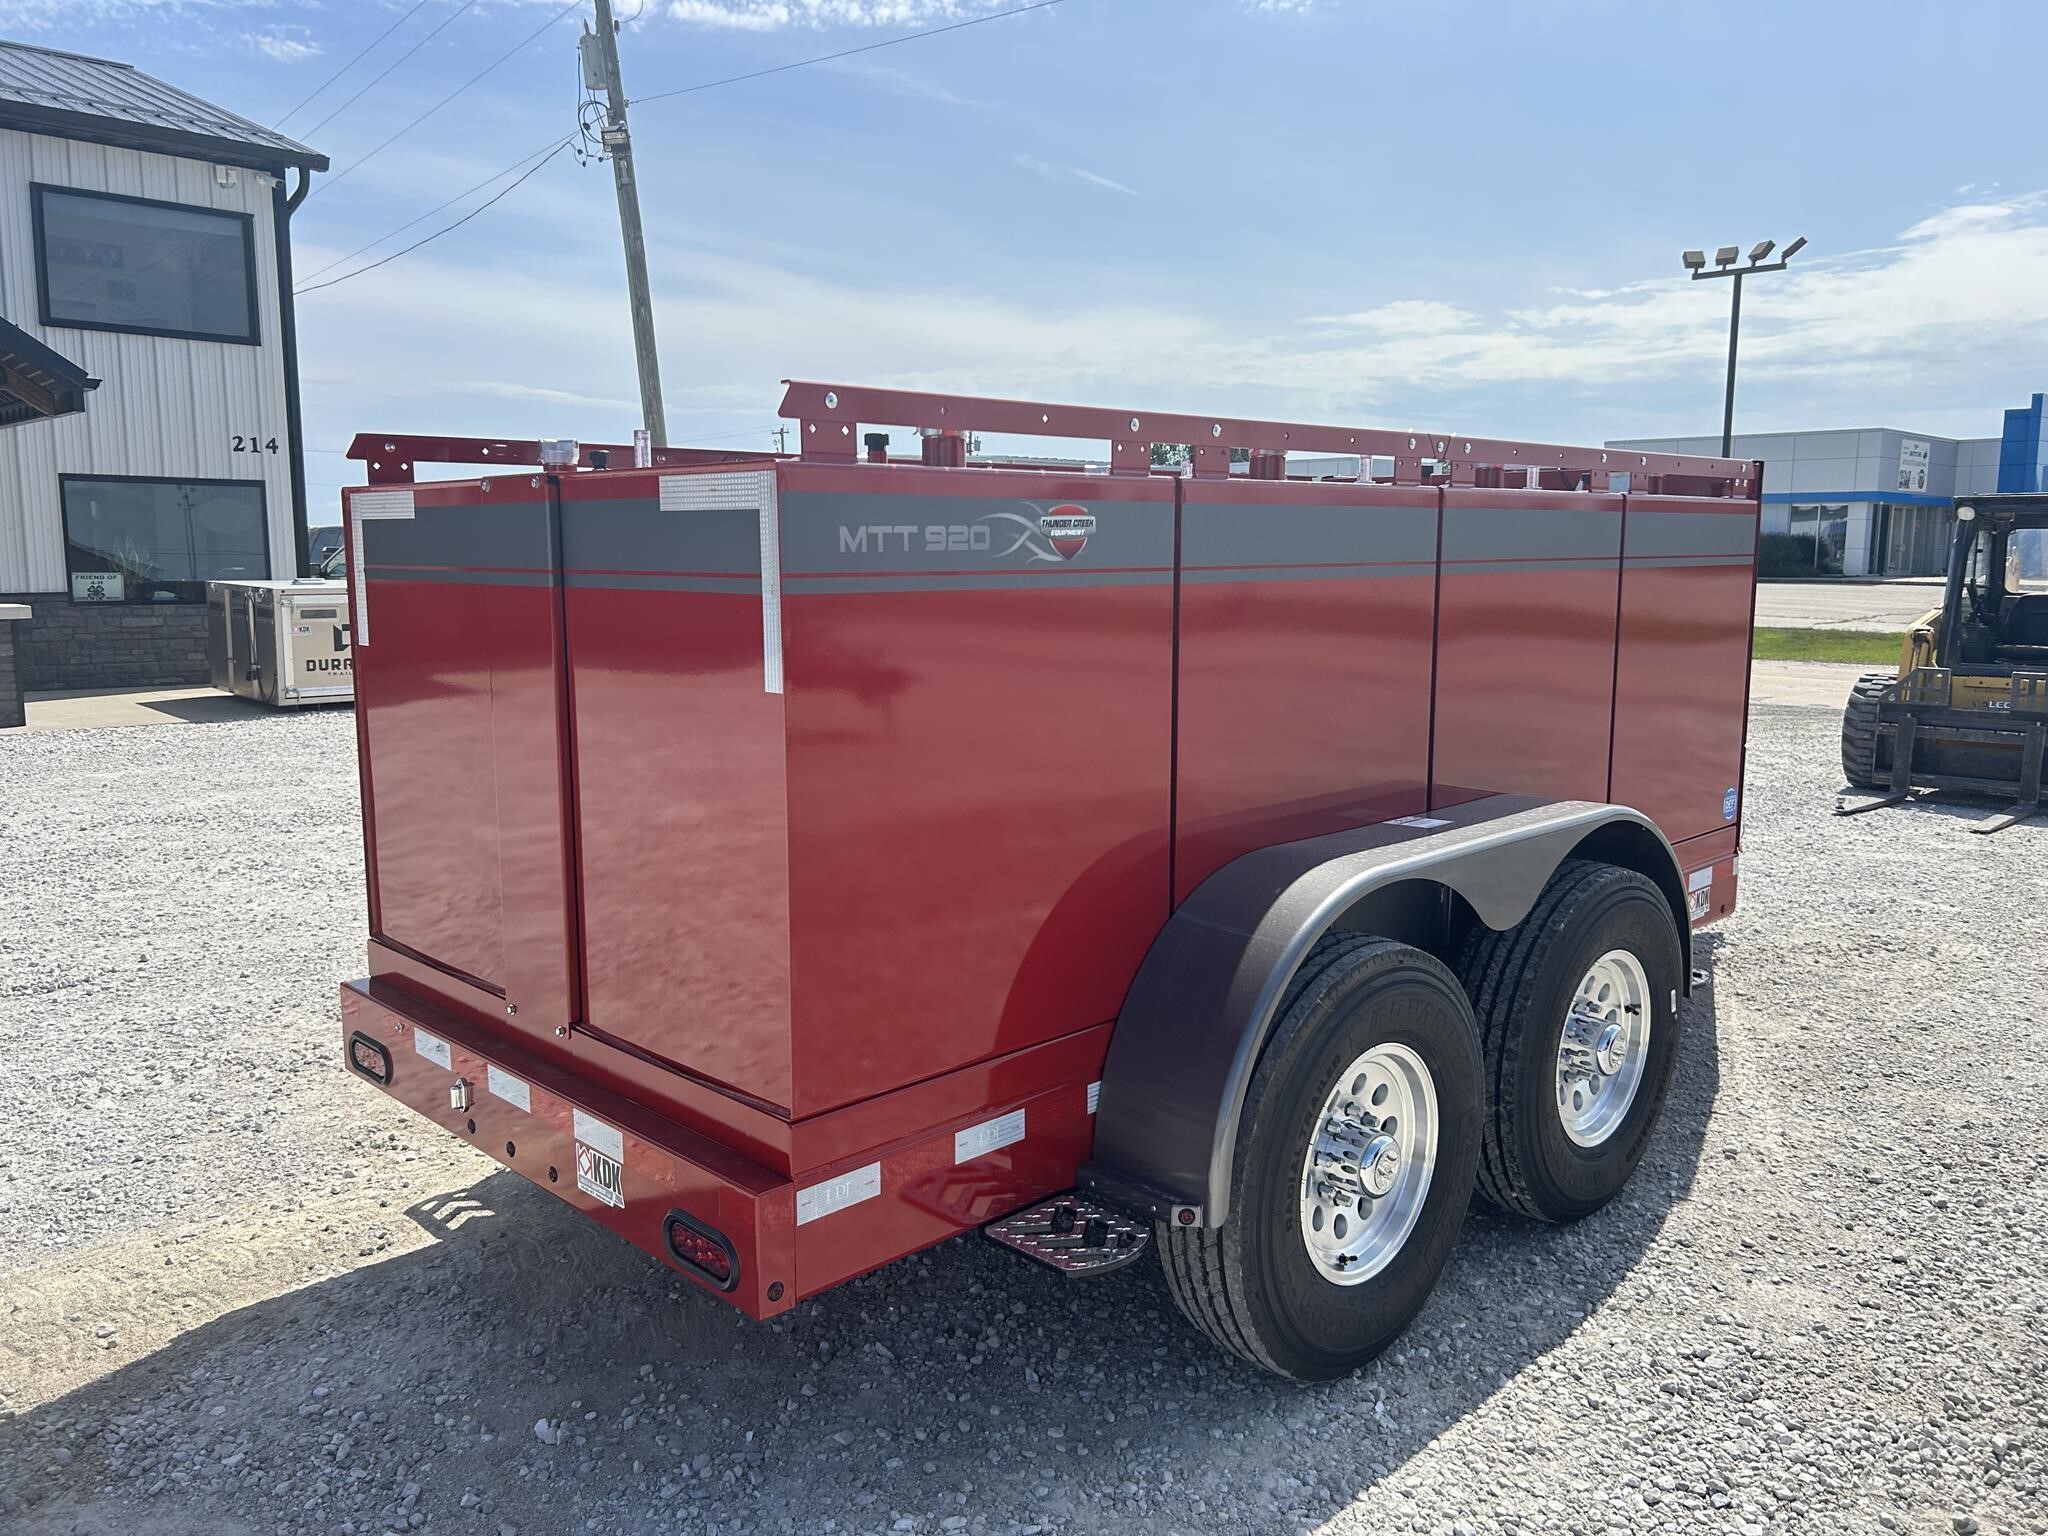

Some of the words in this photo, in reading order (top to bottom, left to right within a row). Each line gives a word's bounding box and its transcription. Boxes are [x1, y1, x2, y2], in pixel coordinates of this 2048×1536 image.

[232, 435, 279, 455] 214
[1041, 519, 1072, 528] THUNDER
[1073, 519, 1094, 528] CREEK
[839, 525, 918, 553] MTT
[924, 525, 990, 551] 920
[1695, 888, 1709, 909] KDK
[593, 1153, 622, 1196] KDK
